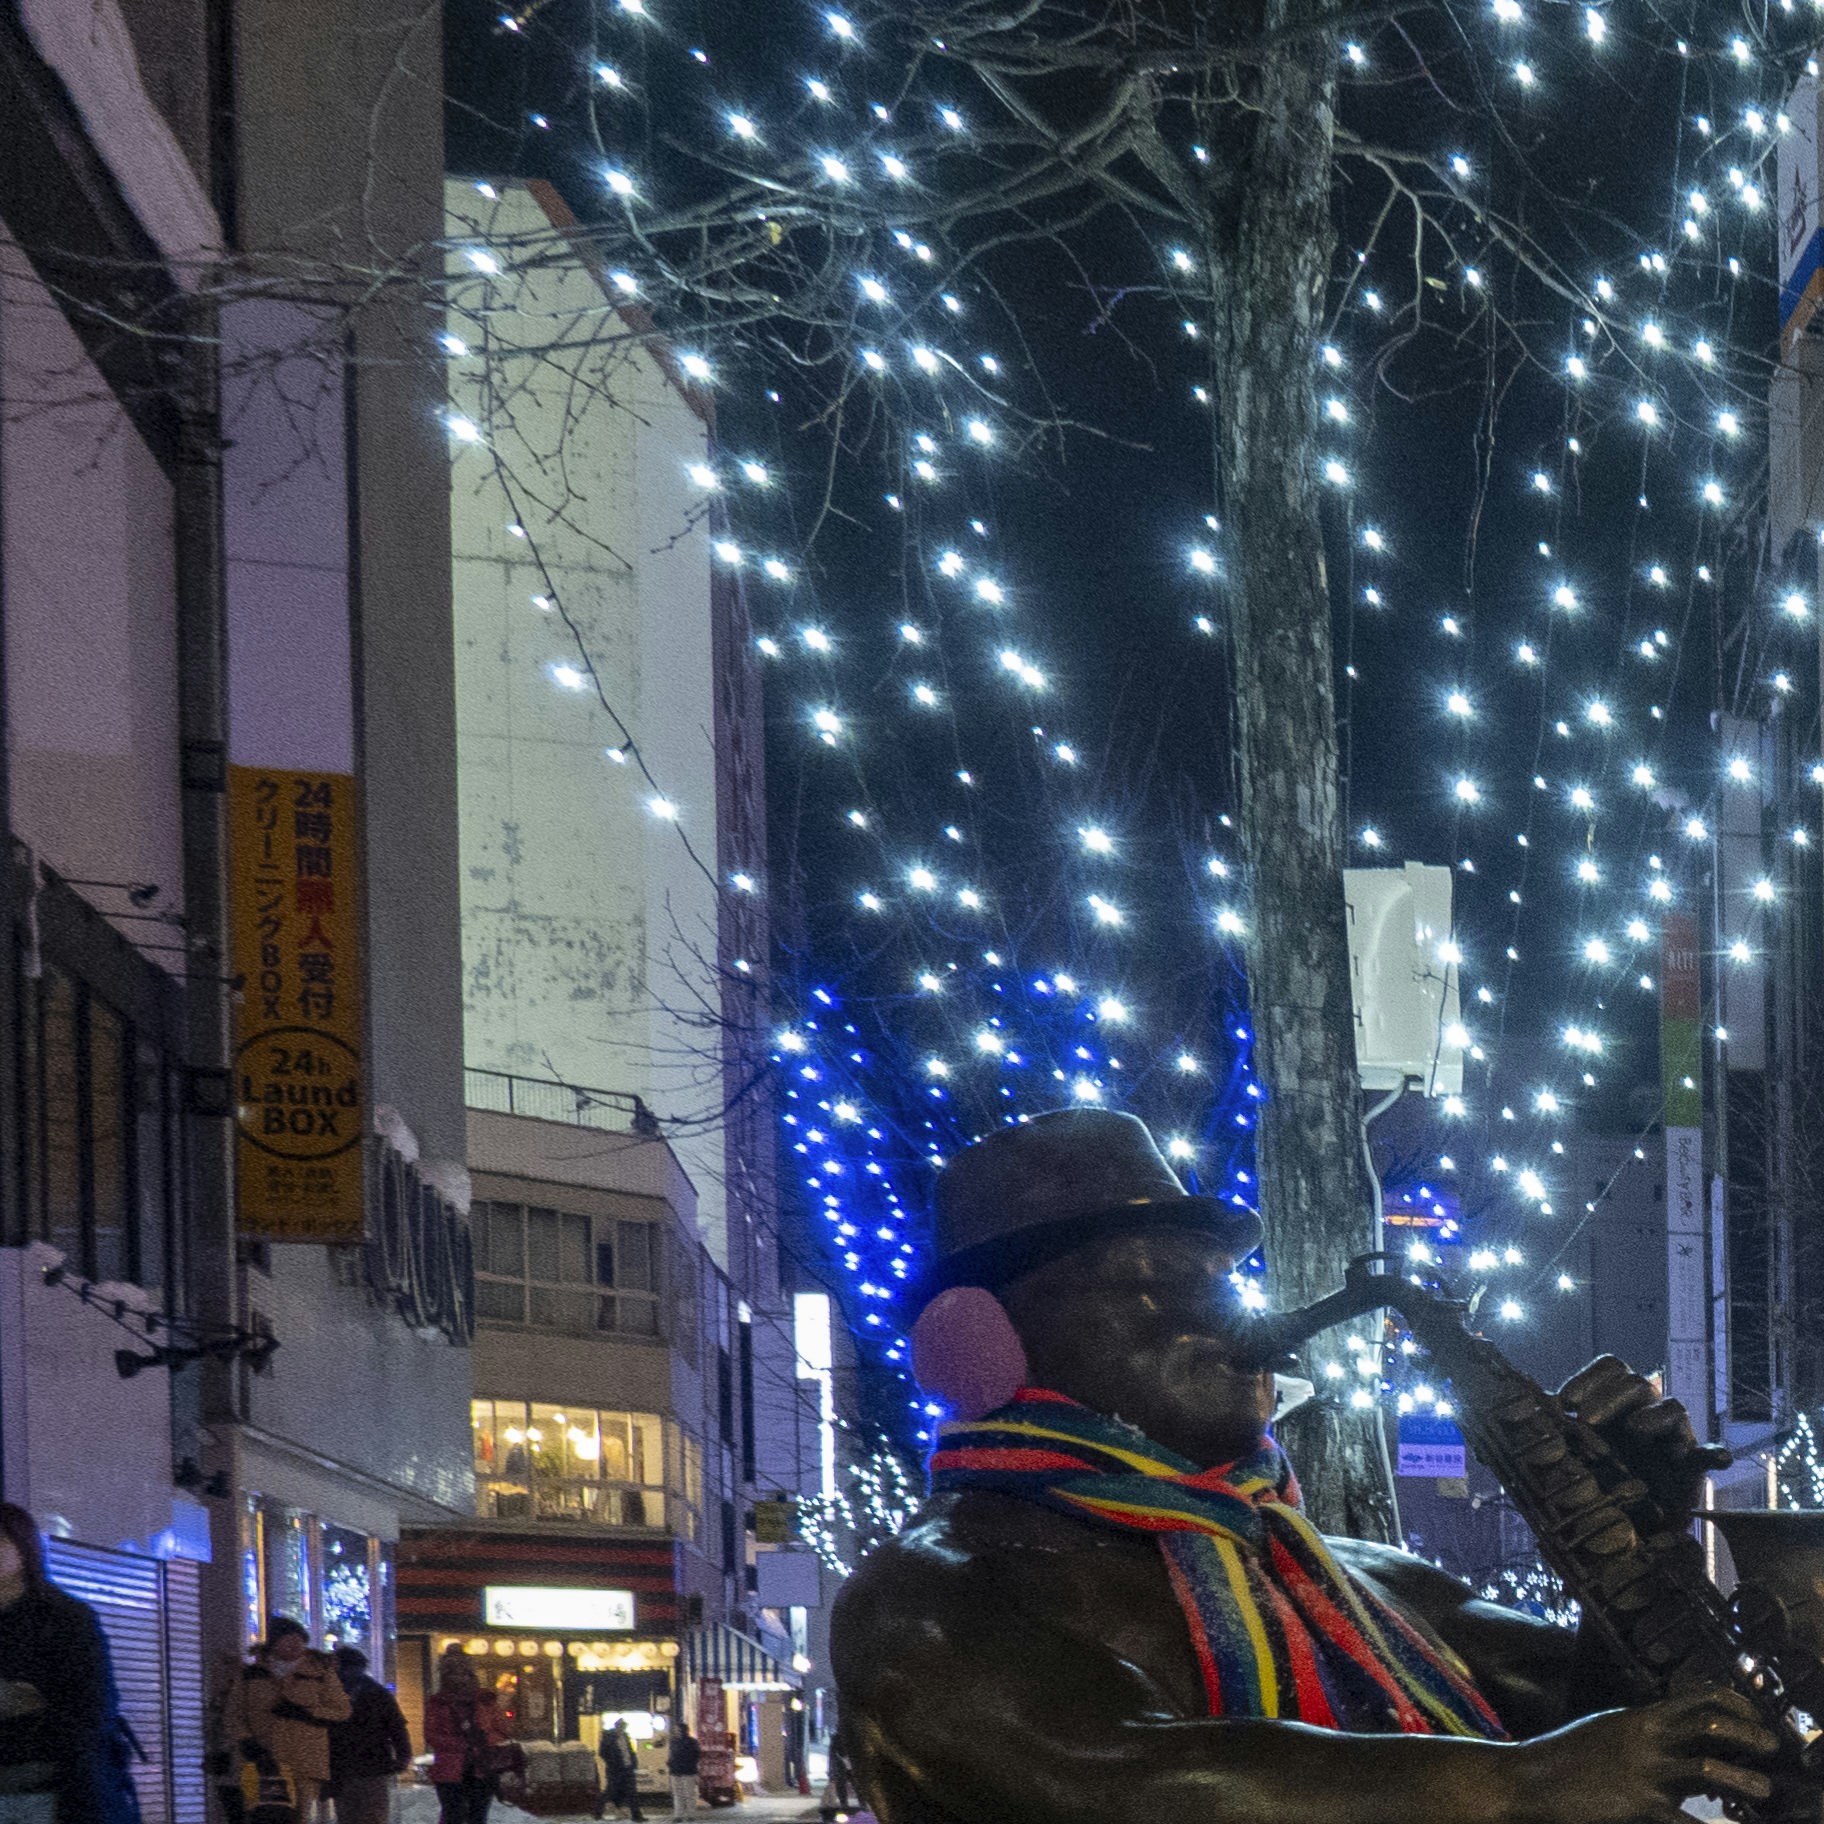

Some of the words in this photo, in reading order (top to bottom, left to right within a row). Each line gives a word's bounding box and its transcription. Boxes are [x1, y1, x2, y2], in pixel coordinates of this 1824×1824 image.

[271, 1049, 332, 1076] 24h
[243, 1074, 357, 1107] Laund
[263, 1107, 340, 1137] BOX
